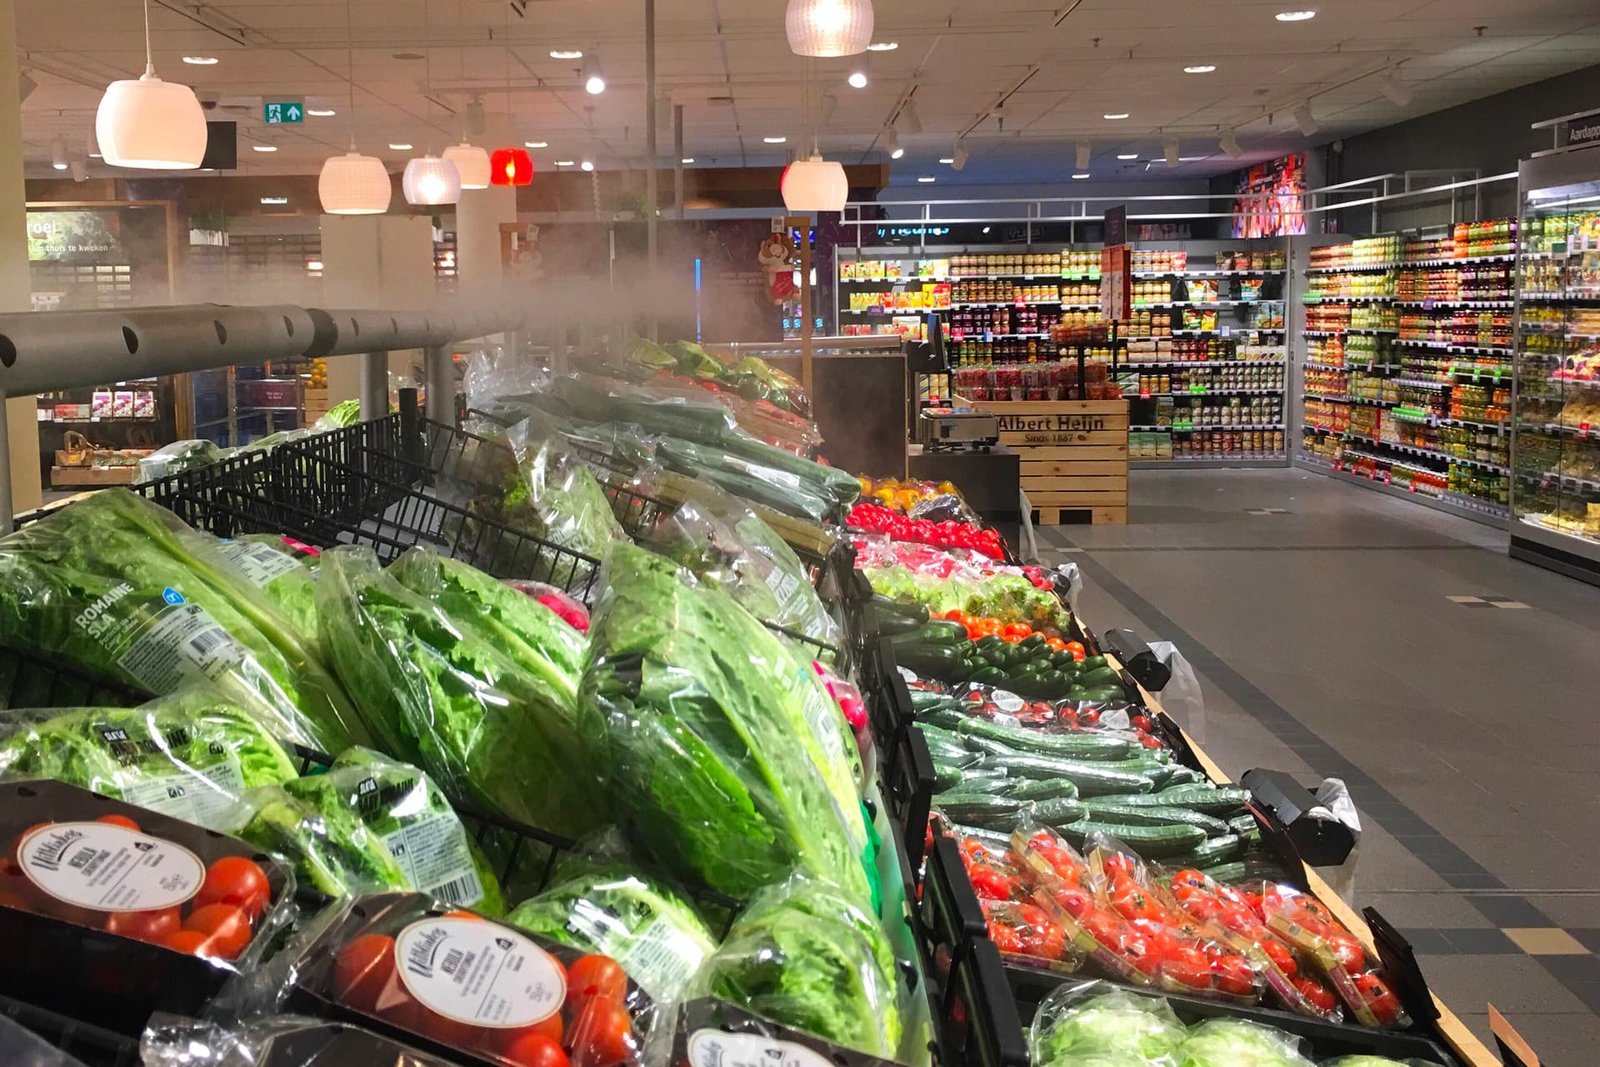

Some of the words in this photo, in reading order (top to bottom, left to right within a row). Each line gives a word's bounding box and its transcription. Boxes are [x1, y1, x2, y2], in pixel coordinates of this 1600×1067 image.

[68, 244, 77, 252] te
[79, 244, 109, 252] kweken
[999, 416, 1052, 430] Albert
[1057, 416, 1105, 433] Heijn
[1024, 434, 1049, 443] Sinds
[1052, 434, 1074, 443] 1887
[75, 582, 135, 630] ROMAINE
[88, 613, 116, 640] SLA
